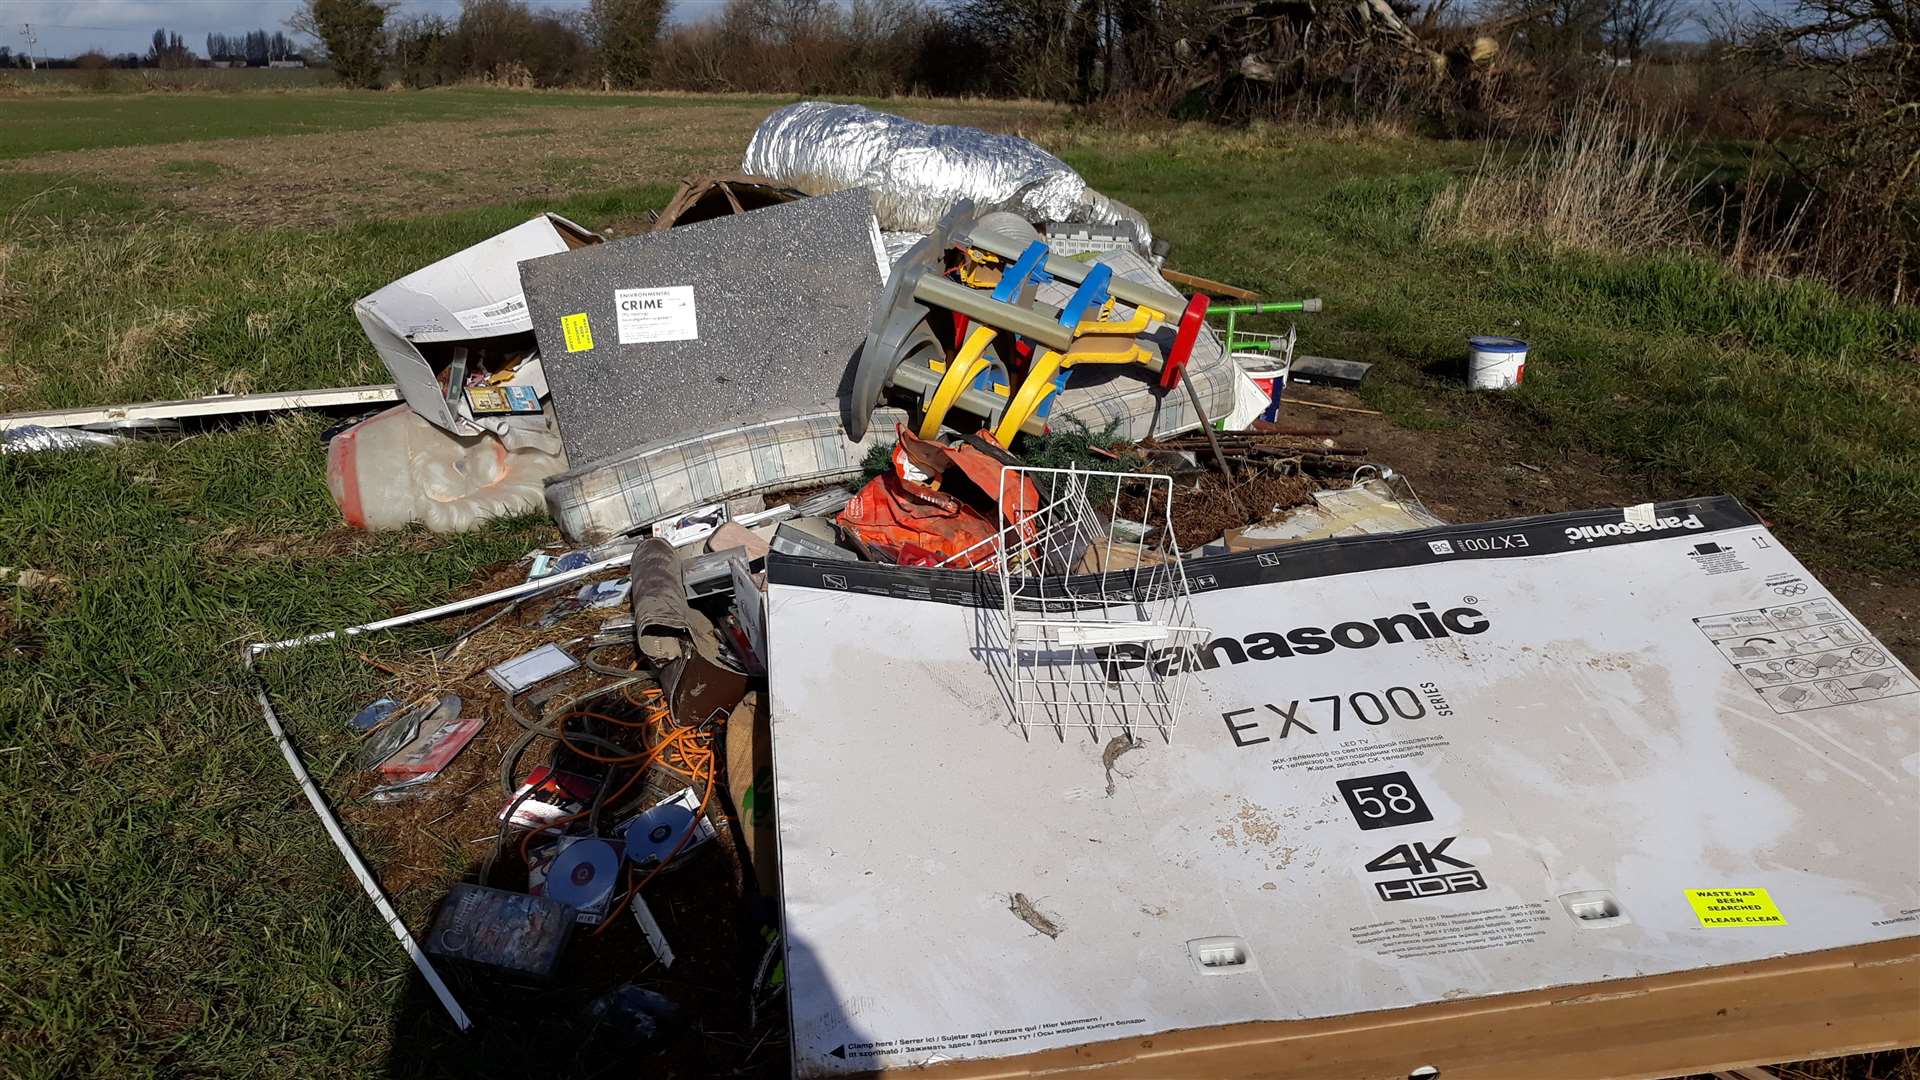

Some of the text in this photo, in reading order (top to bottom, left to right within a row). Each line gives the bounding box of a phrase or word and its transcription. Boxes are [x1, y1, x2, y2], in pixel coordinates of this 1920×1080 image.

[620, 290, 671, 299] ENVIRONMENTAL
[621, 298, 663, 311] CRIME
[1564, 514, 1704, 543] Panasonic
[1465, 534, 1529, 551] EX700
[1093, 601, 1490, 682] Panasonic
[1420, 682, 1454, 717] SERIES
[1221, 686, 1427, 747] EX700
[1272, 751, 1330, 765] ЖК-телевизор
[1341, 741, 1398, 755] светодиодной
[1339, 740, 1357, 748] LED
[1352, 783, 1416, 819] 58
[1365, 836, 1476, 876] 4K
[1379, 872, 1484, 900] HDR
[1707, 904, 1762, 912] SEARCHED
[1745, 915, 1781, 923] CLEAR
[848, 1042, 874, 1050] Clamp
[900, 1038, 924, 1046] Serrer
[941, 1033, 969, 1042] Sujetar
[993, 1027, 1023, 1036] Pinzare
[1060, 1016, 1099, 1026] klammern
[905, 1044, 946, 1053] Зажимать
[948, 1041, 972, 1049] здесь
[977, 1036, 1018, 1046] Затискати
[1037, 1030, 1055, 1038] Осы
